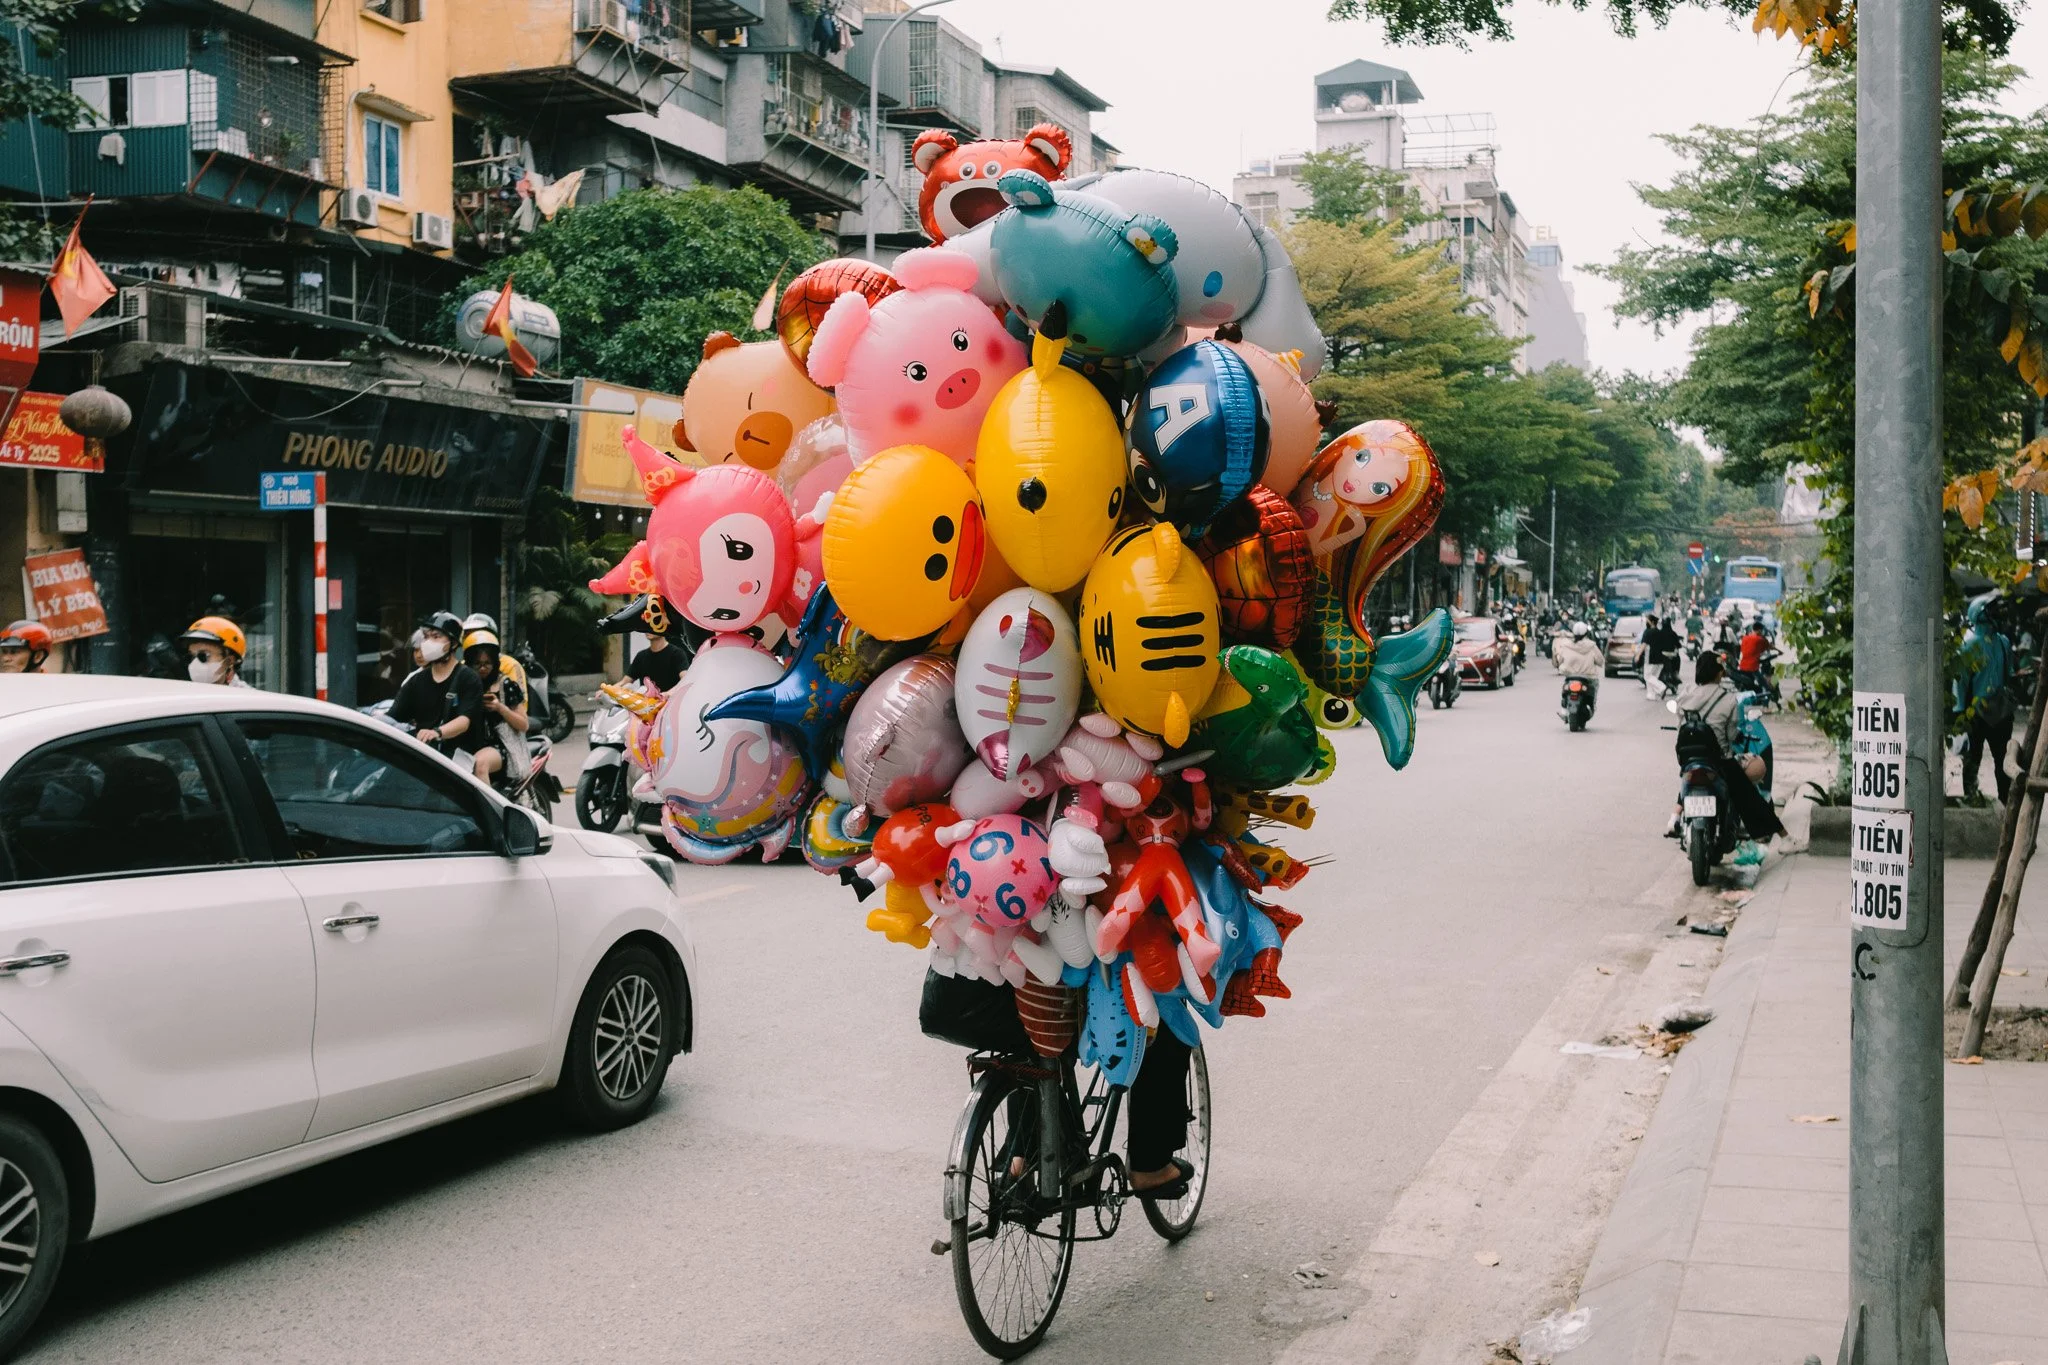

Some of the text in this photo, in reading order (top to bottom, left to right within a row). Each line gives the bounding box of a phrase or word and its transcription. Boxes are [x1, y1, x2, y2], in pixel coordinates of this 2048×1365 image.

[1150, 383, 1212, 456] A
[28, 444, 60, 463] 2025
[282, 431, 450, 480] PHONG AUDIO
[31, 566, 61, 588] BIA
[37, 593, 61, 618] LÝ
[1857, 699, 1900, 733] TIỀN
[1876, 742, 1887, 755] UY
[1888, 740, 1902, 756] TÍN
[1859, 819, 1904, 855] TIỀN
[948, 857, 972, 899] 8
[1879, 862, 1889, 876] UY
[1890, 862, 1904, 877] TÍN
